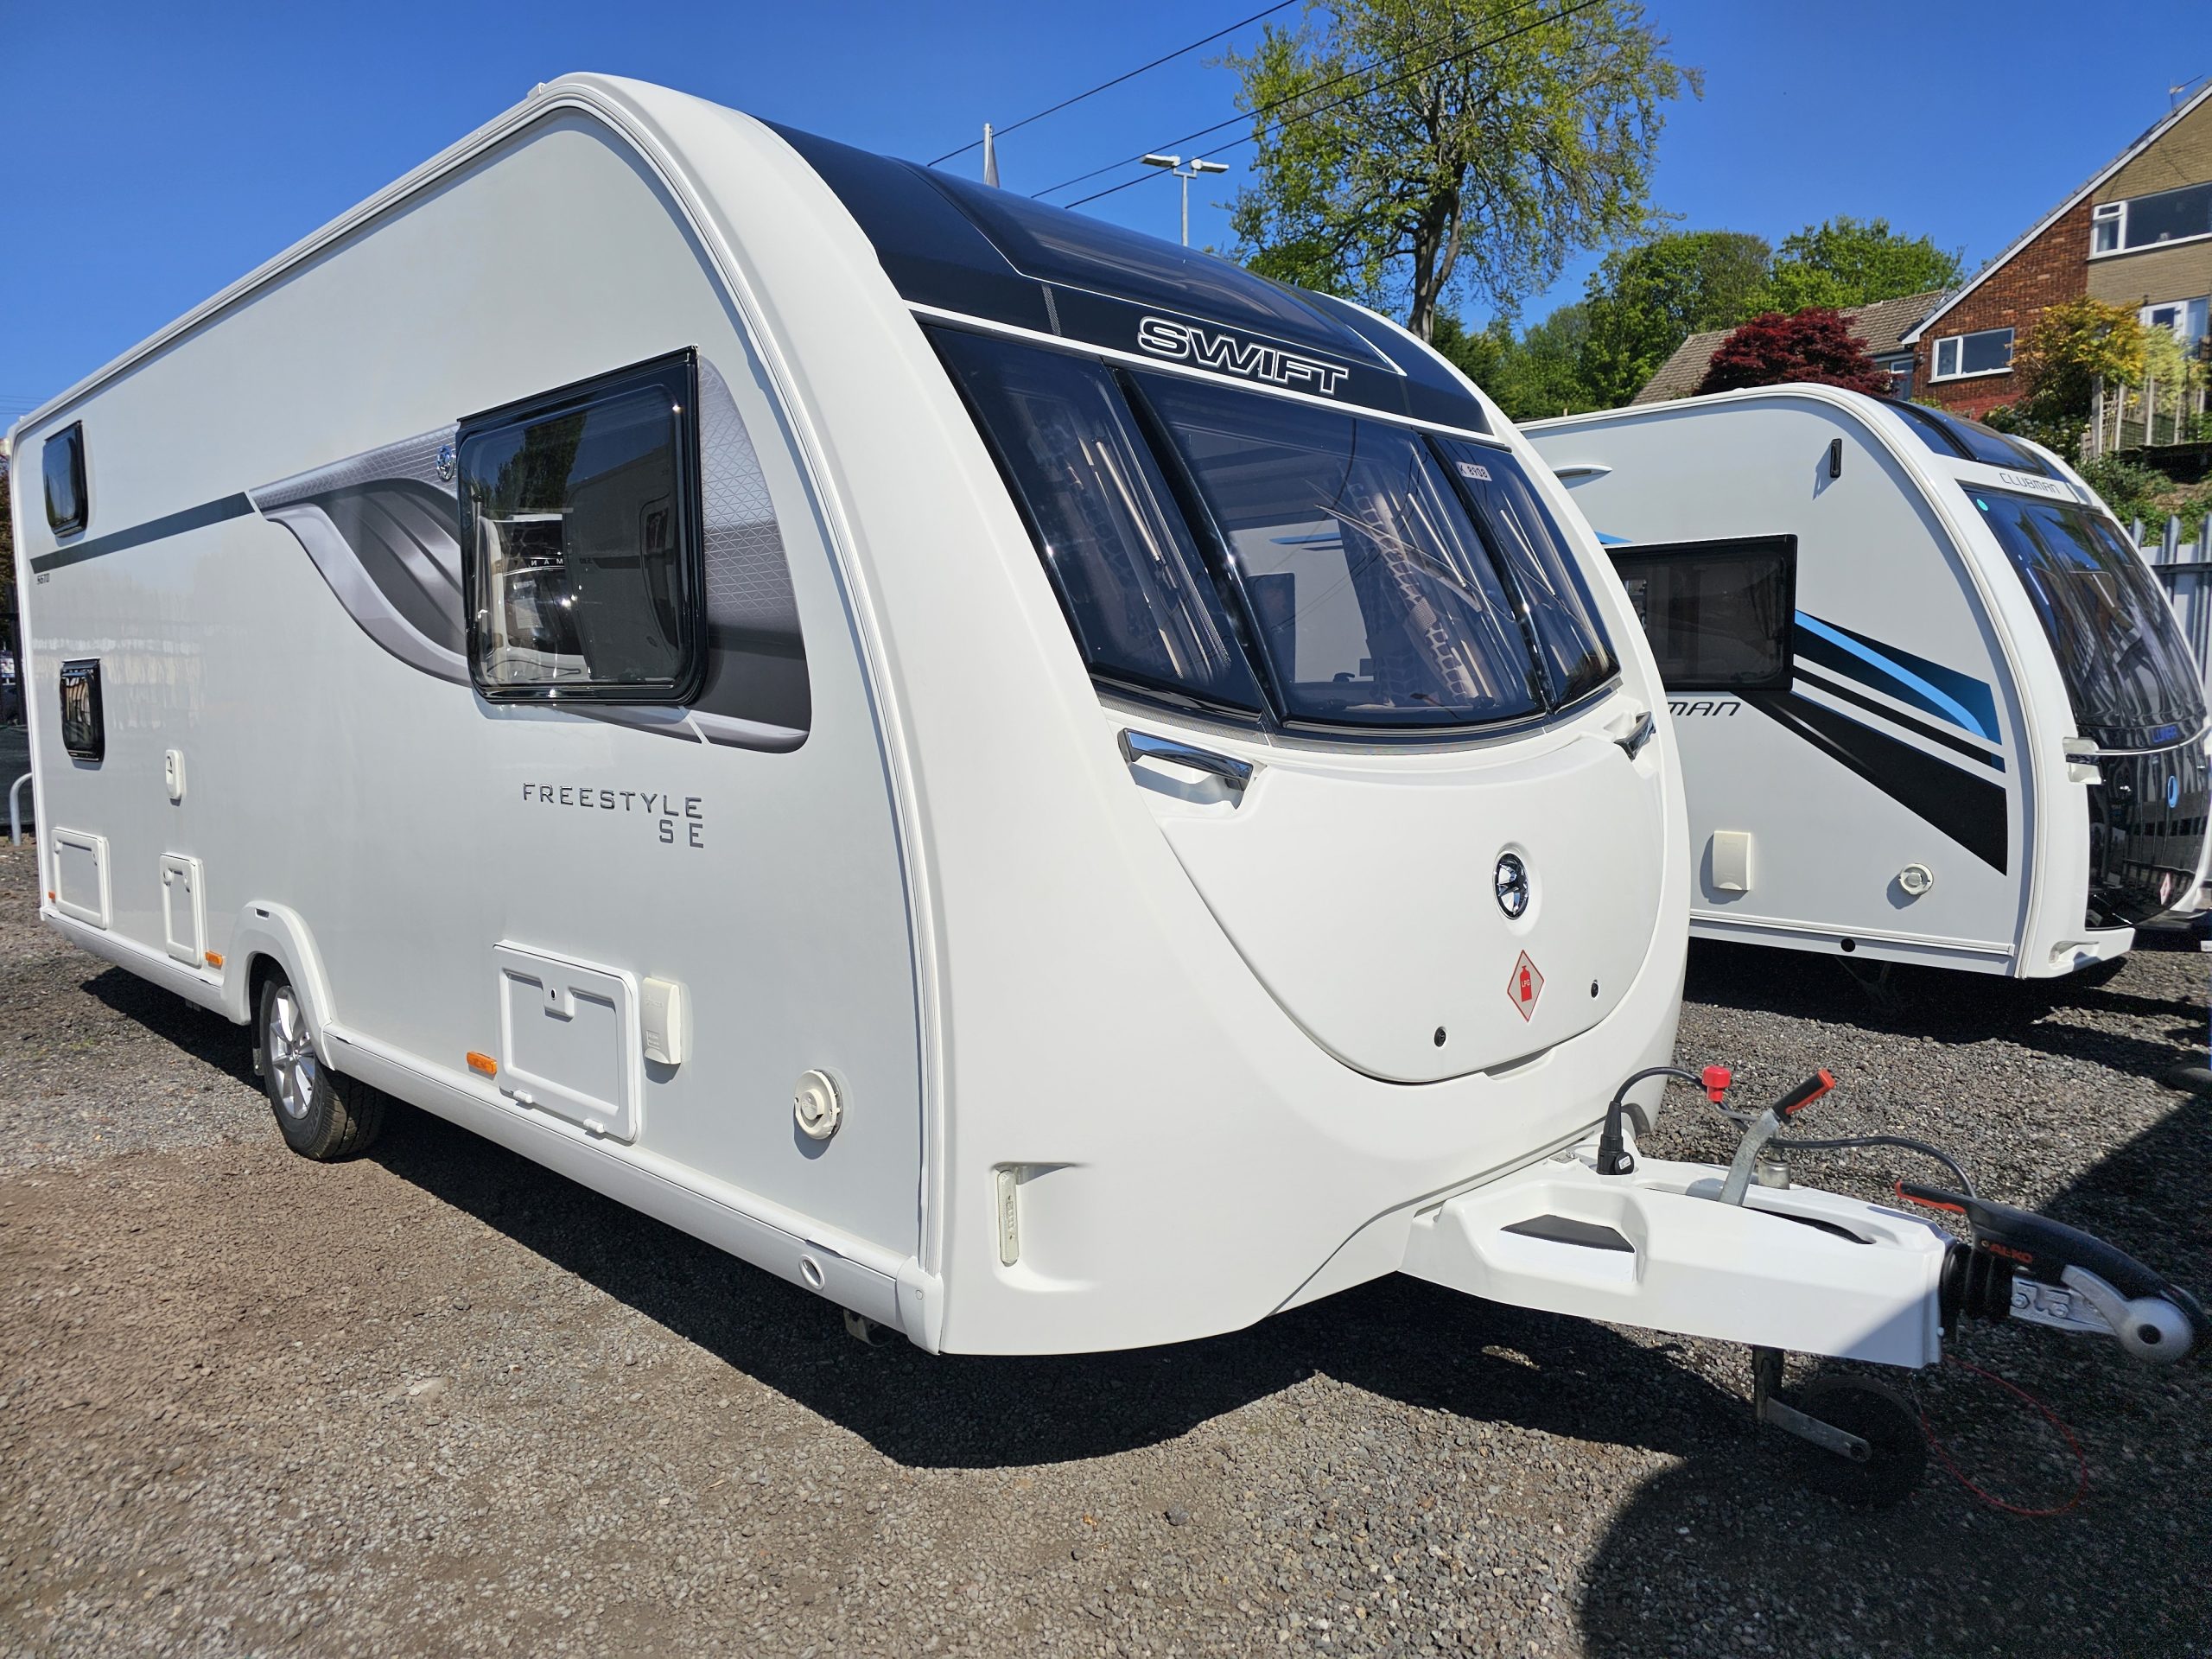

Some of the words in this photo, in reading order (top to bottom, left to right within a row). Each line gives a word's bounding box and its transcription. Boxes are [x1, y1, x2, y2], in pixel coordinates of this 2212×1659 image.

[1137, 316, 1349, 395] SWIFT
[1999, 473, 2061, 494] CLUBMAN
[523, 783, 702, 819] FREESTYLE
[1521, 979, 1530, 988] LPG
